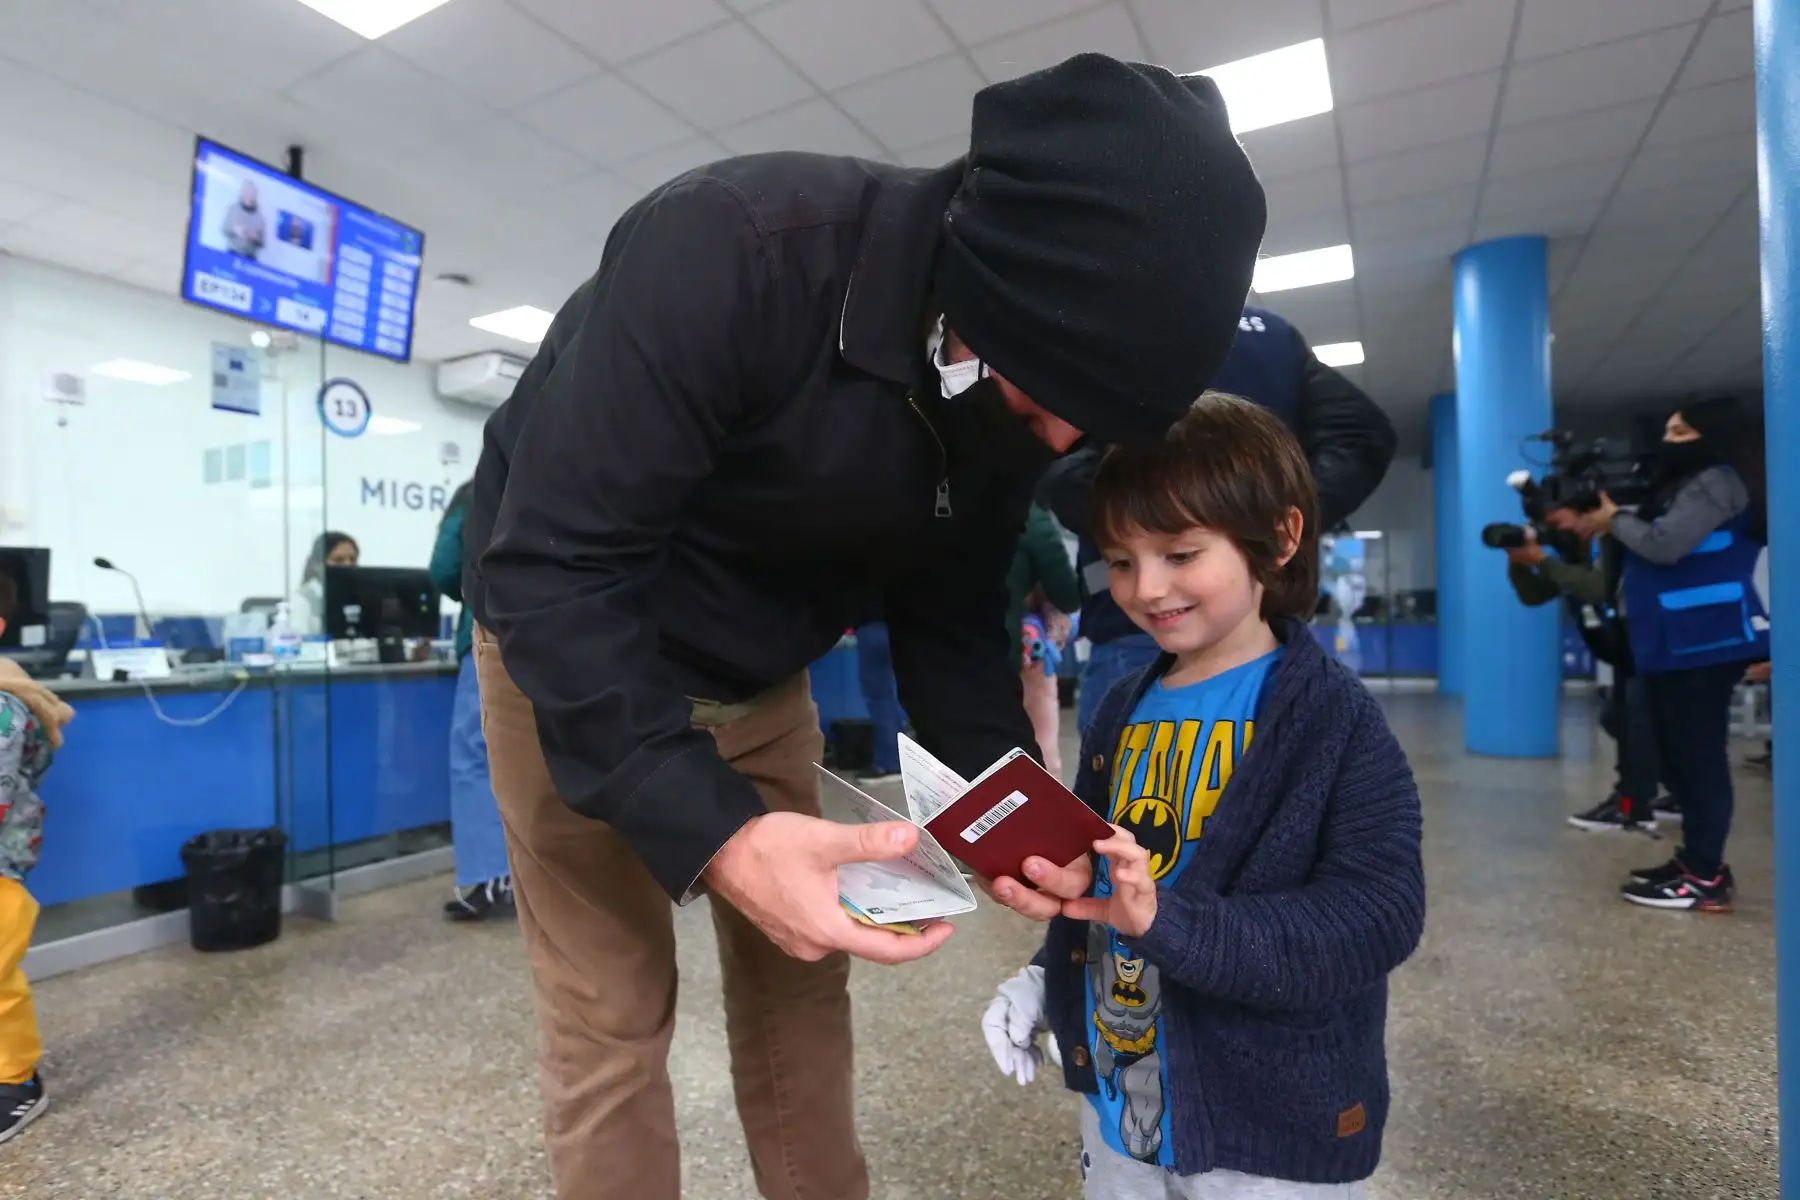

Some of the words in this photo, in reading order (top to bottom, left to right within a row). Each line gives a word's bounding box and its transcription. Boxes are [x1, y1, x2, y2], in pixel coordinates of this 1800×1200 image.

[334, 399, 358, 418] 13
[360, 475, 448, 512] MIGR
[1109, 718, 1255, 843] TMA
